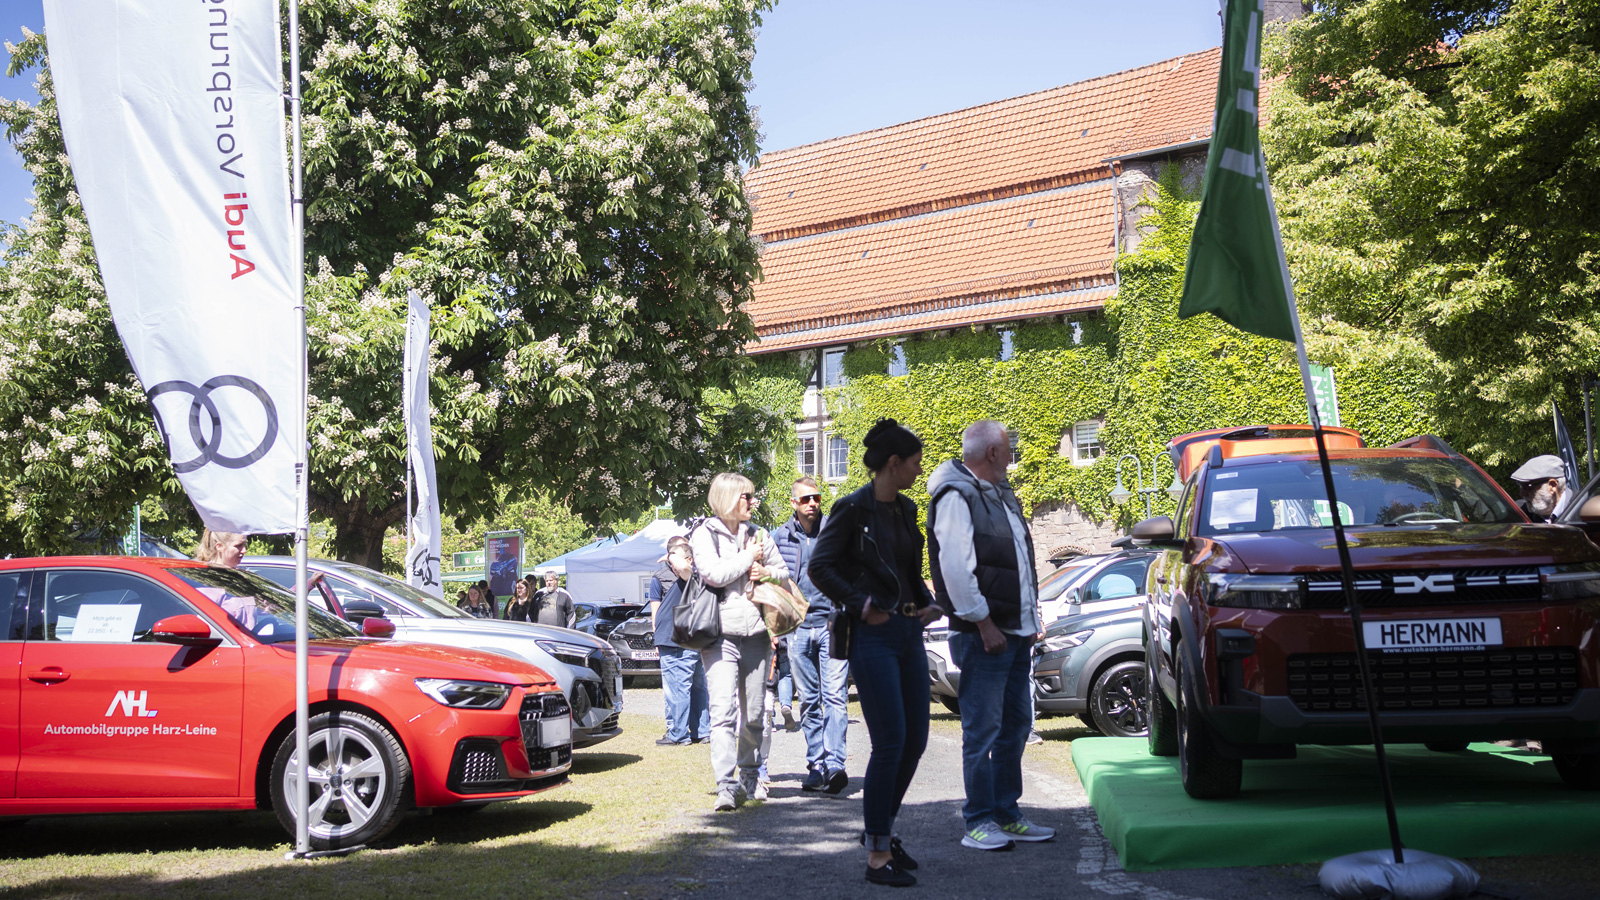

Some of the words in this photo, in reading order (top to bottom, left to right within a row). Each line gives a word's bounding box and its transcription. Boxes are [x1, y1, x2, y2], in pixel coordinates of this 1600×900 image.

[1381, 622, 1486, 645] HERMANN
[1383, 645, 1486, 653] www.autohaus-hermann.de
[44, 723, 149, 737] Automobilgruppe
[152, 724, 217, 736] Harz-Leine
